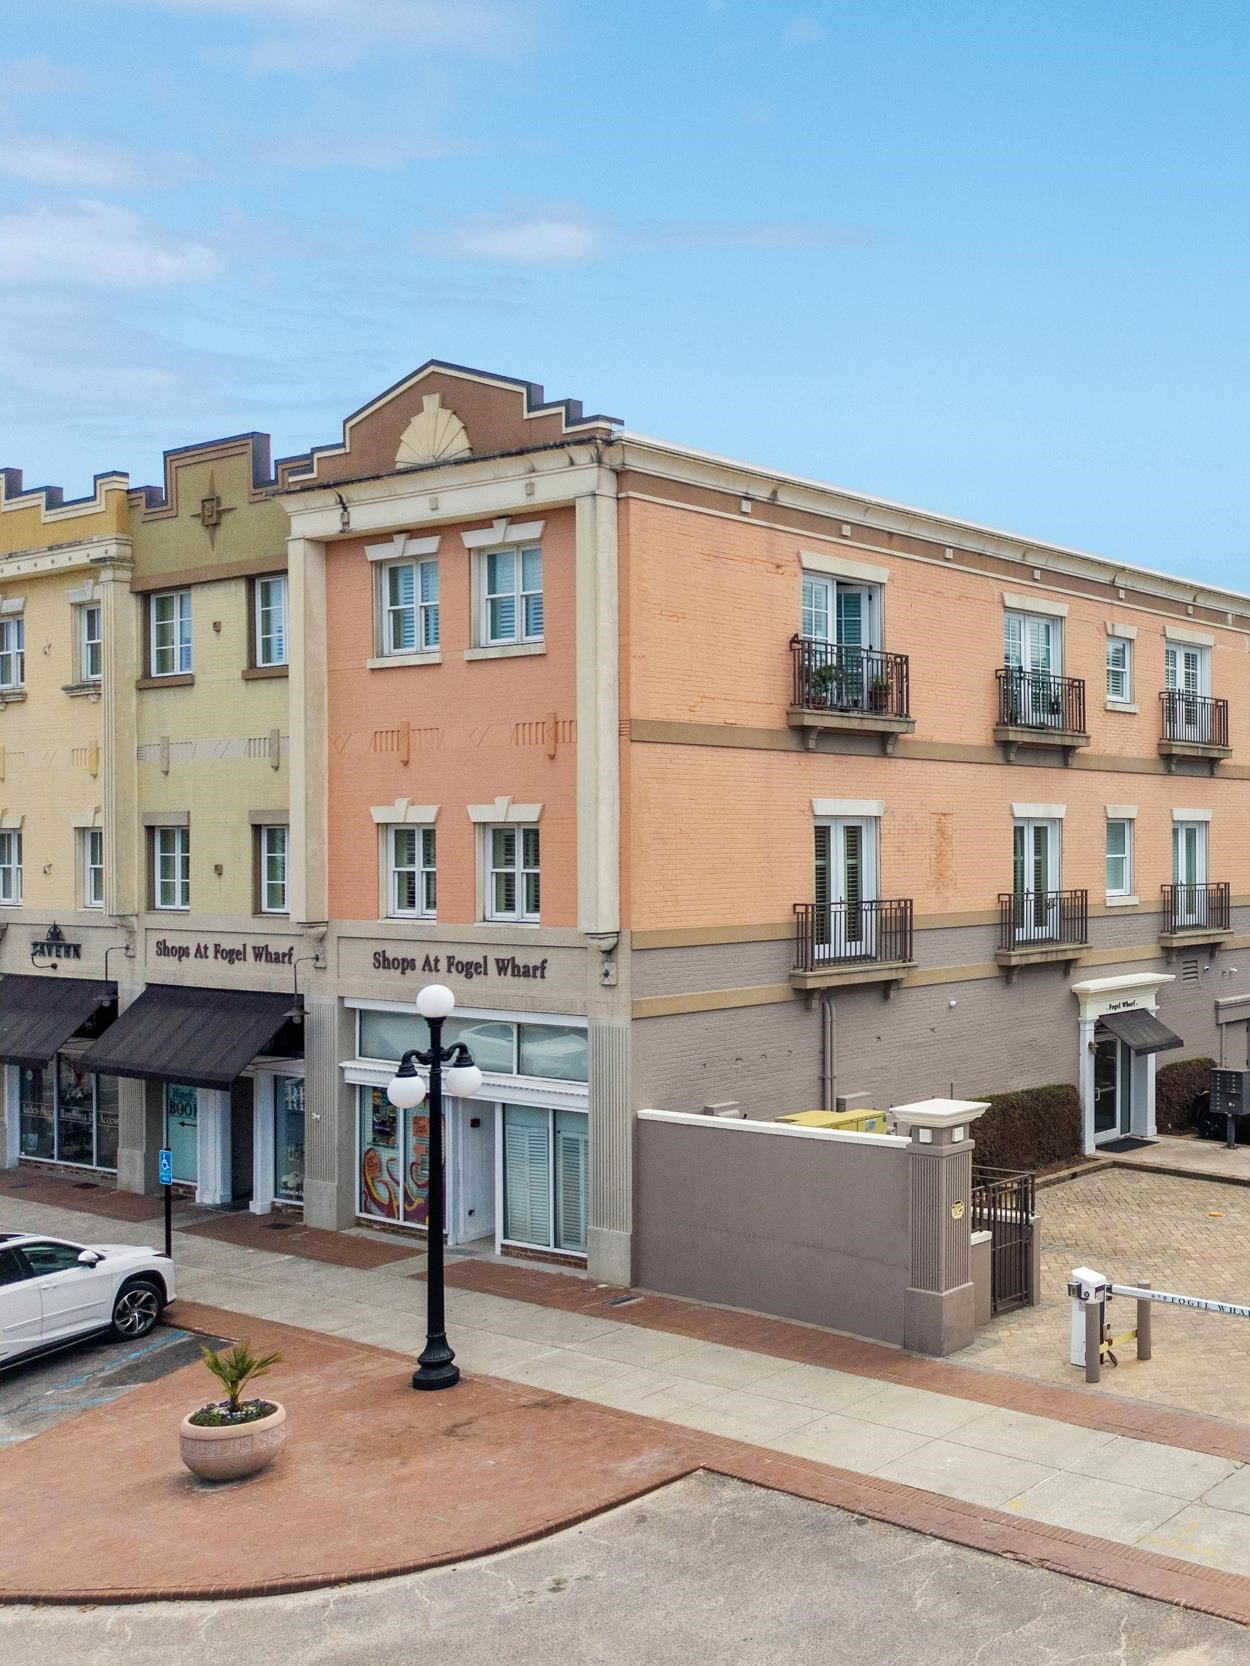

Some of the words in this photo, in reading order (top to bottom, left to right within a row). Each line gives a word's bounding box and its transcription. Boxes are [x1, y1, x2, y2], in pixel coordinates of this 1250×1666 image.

[31, 941, 81, 959] TAVERN
[155, 939, 190, 962] Shops
[194, 942, 209, 959] At
[213, 943, 247, 964] Fogel
[252, 944, 294, 965] Wharf
[373, 950, 416, 975] Shops
[421, 954, 440, 973] At
[446, 955, 488, 979] Fogel
[494, 956, 548, 979] Wharf
[1171, 1296, 1209, 1311] FOGEL
